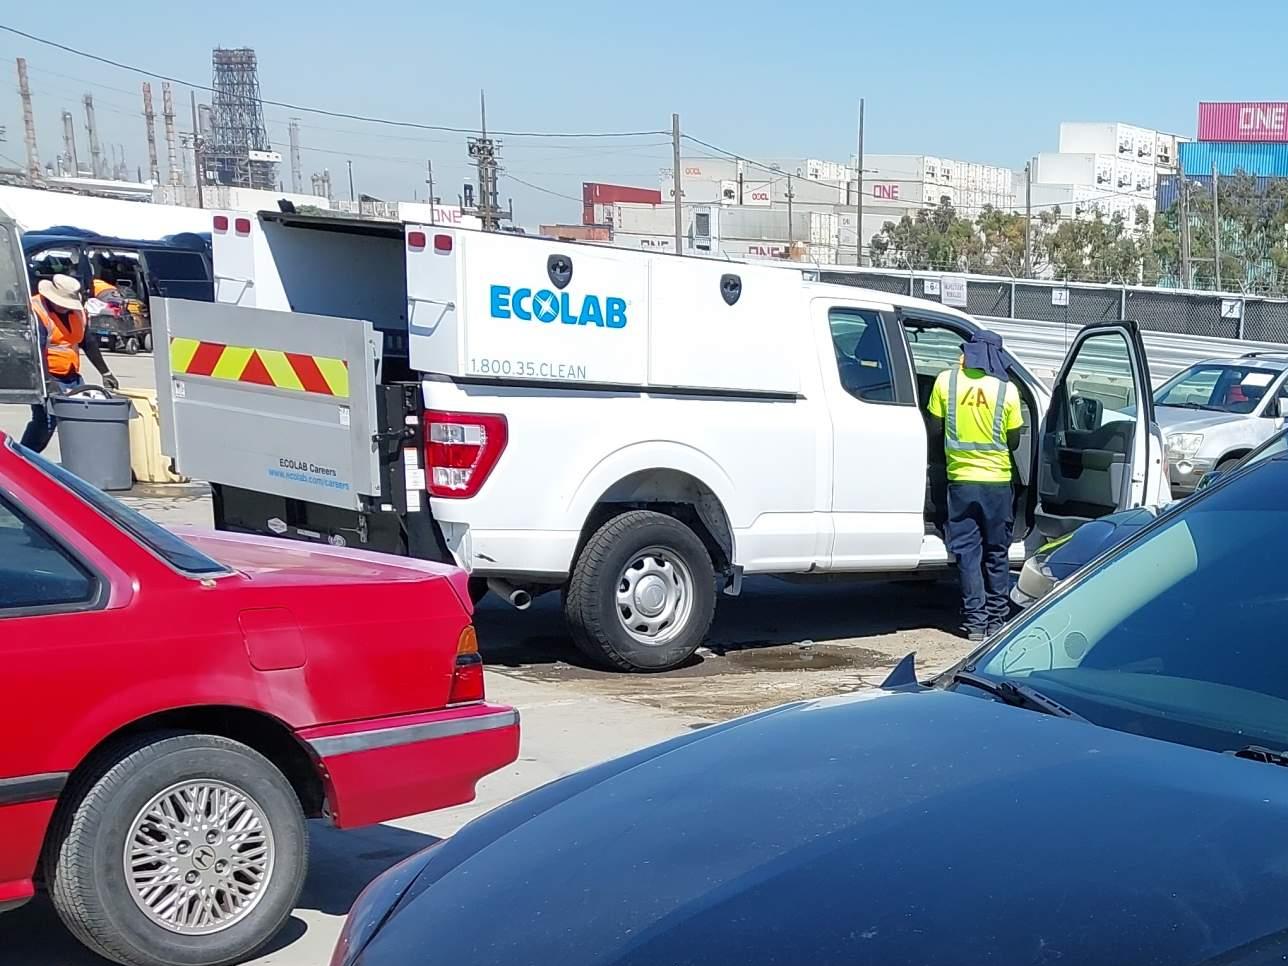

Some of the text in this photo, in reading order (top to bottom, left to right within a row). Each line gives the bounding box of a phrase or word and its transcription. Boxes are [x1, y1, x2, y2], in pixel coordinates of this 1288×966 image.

[1240, 107, 1284, 130] ONE
[873, 184, 899, 200] ONE
[490, 284, 628, 329] ECOLAB
[1058, 292, 1063, 301] 7
[471, 358, 587, 380] 1.800.35.CLEAN
[279, 458, 337, 477] ECOLAB Careers
[268, 468, 350, 491] www.ecolab.com/careers
